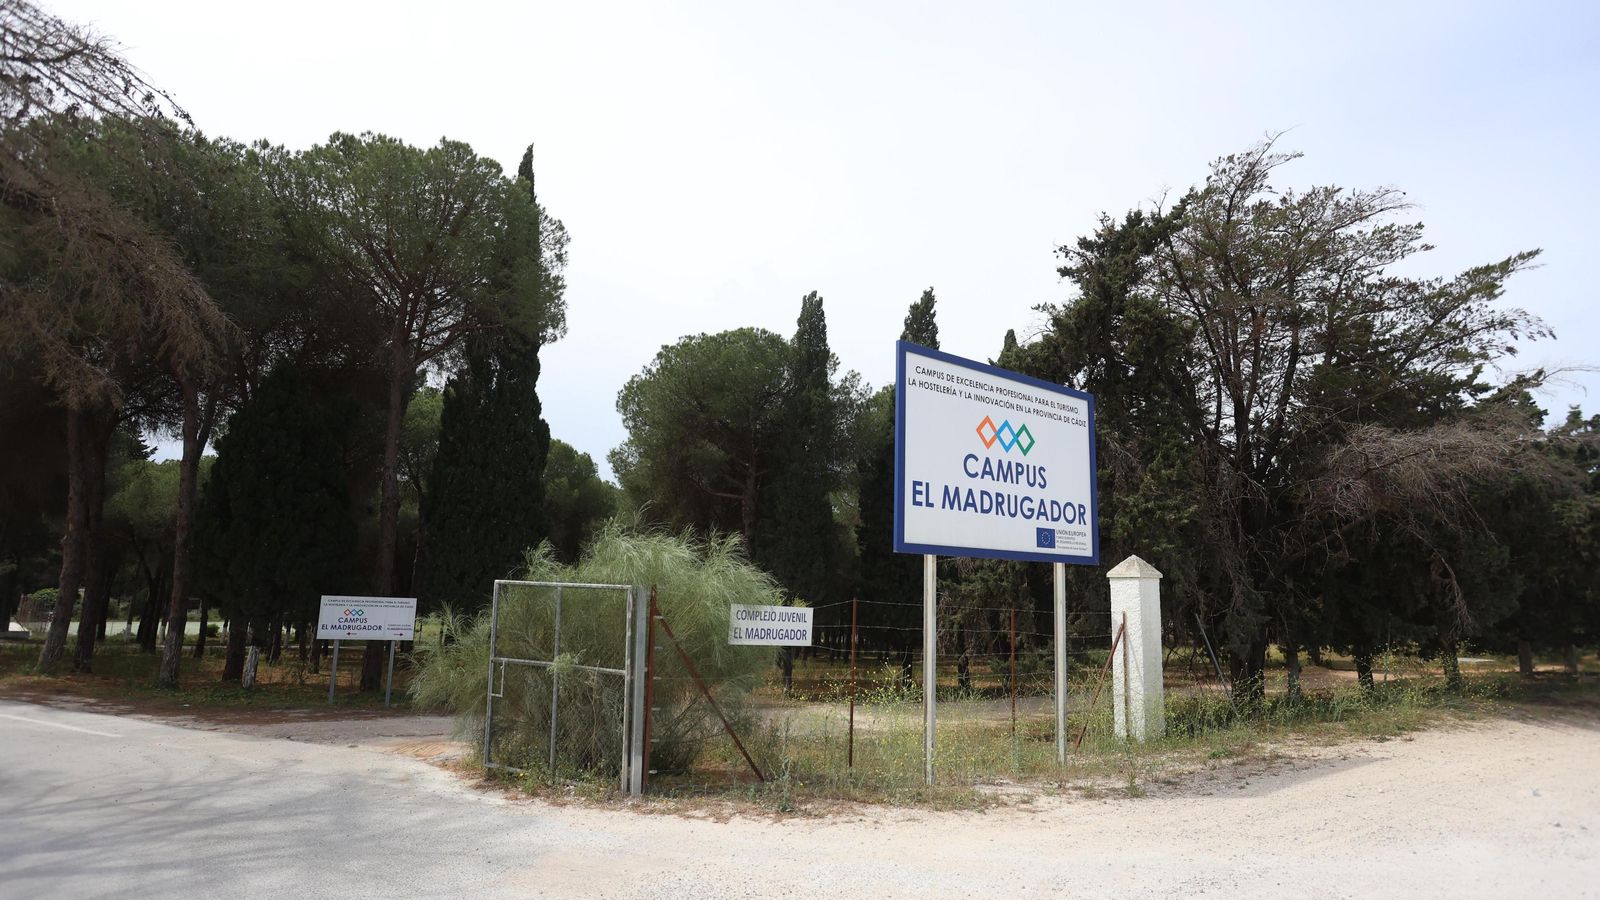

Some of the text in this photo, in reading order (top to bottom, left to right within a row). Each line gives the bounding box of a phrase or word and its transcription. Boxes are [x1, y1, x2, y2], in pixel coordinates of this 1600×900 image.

[908, 377, 1087, 427] LA HOSTELERÍA Y LA INNOVACIÓN EN LA PROVINCIA DE CÁDIZ
[916, 366, 945, 381] CAMPUS
[946, 373, 955, 383] DE
[957, 376, 994, 392] EXCELENCIA
[996, 387, 1034, 403] PROFESIONAL
[1035, 396, 1049, 407] PARA
[1050, 400, 1056, 408] EL
[963, 453, 1047, 489] CAMPUS
[912, 480, 1087, 526] EL MADRUGADOR
[734, 627, 807, 640] EL MADRUGADOR
[736, 610, 807, 623] COMPLEJO JUVENIL
